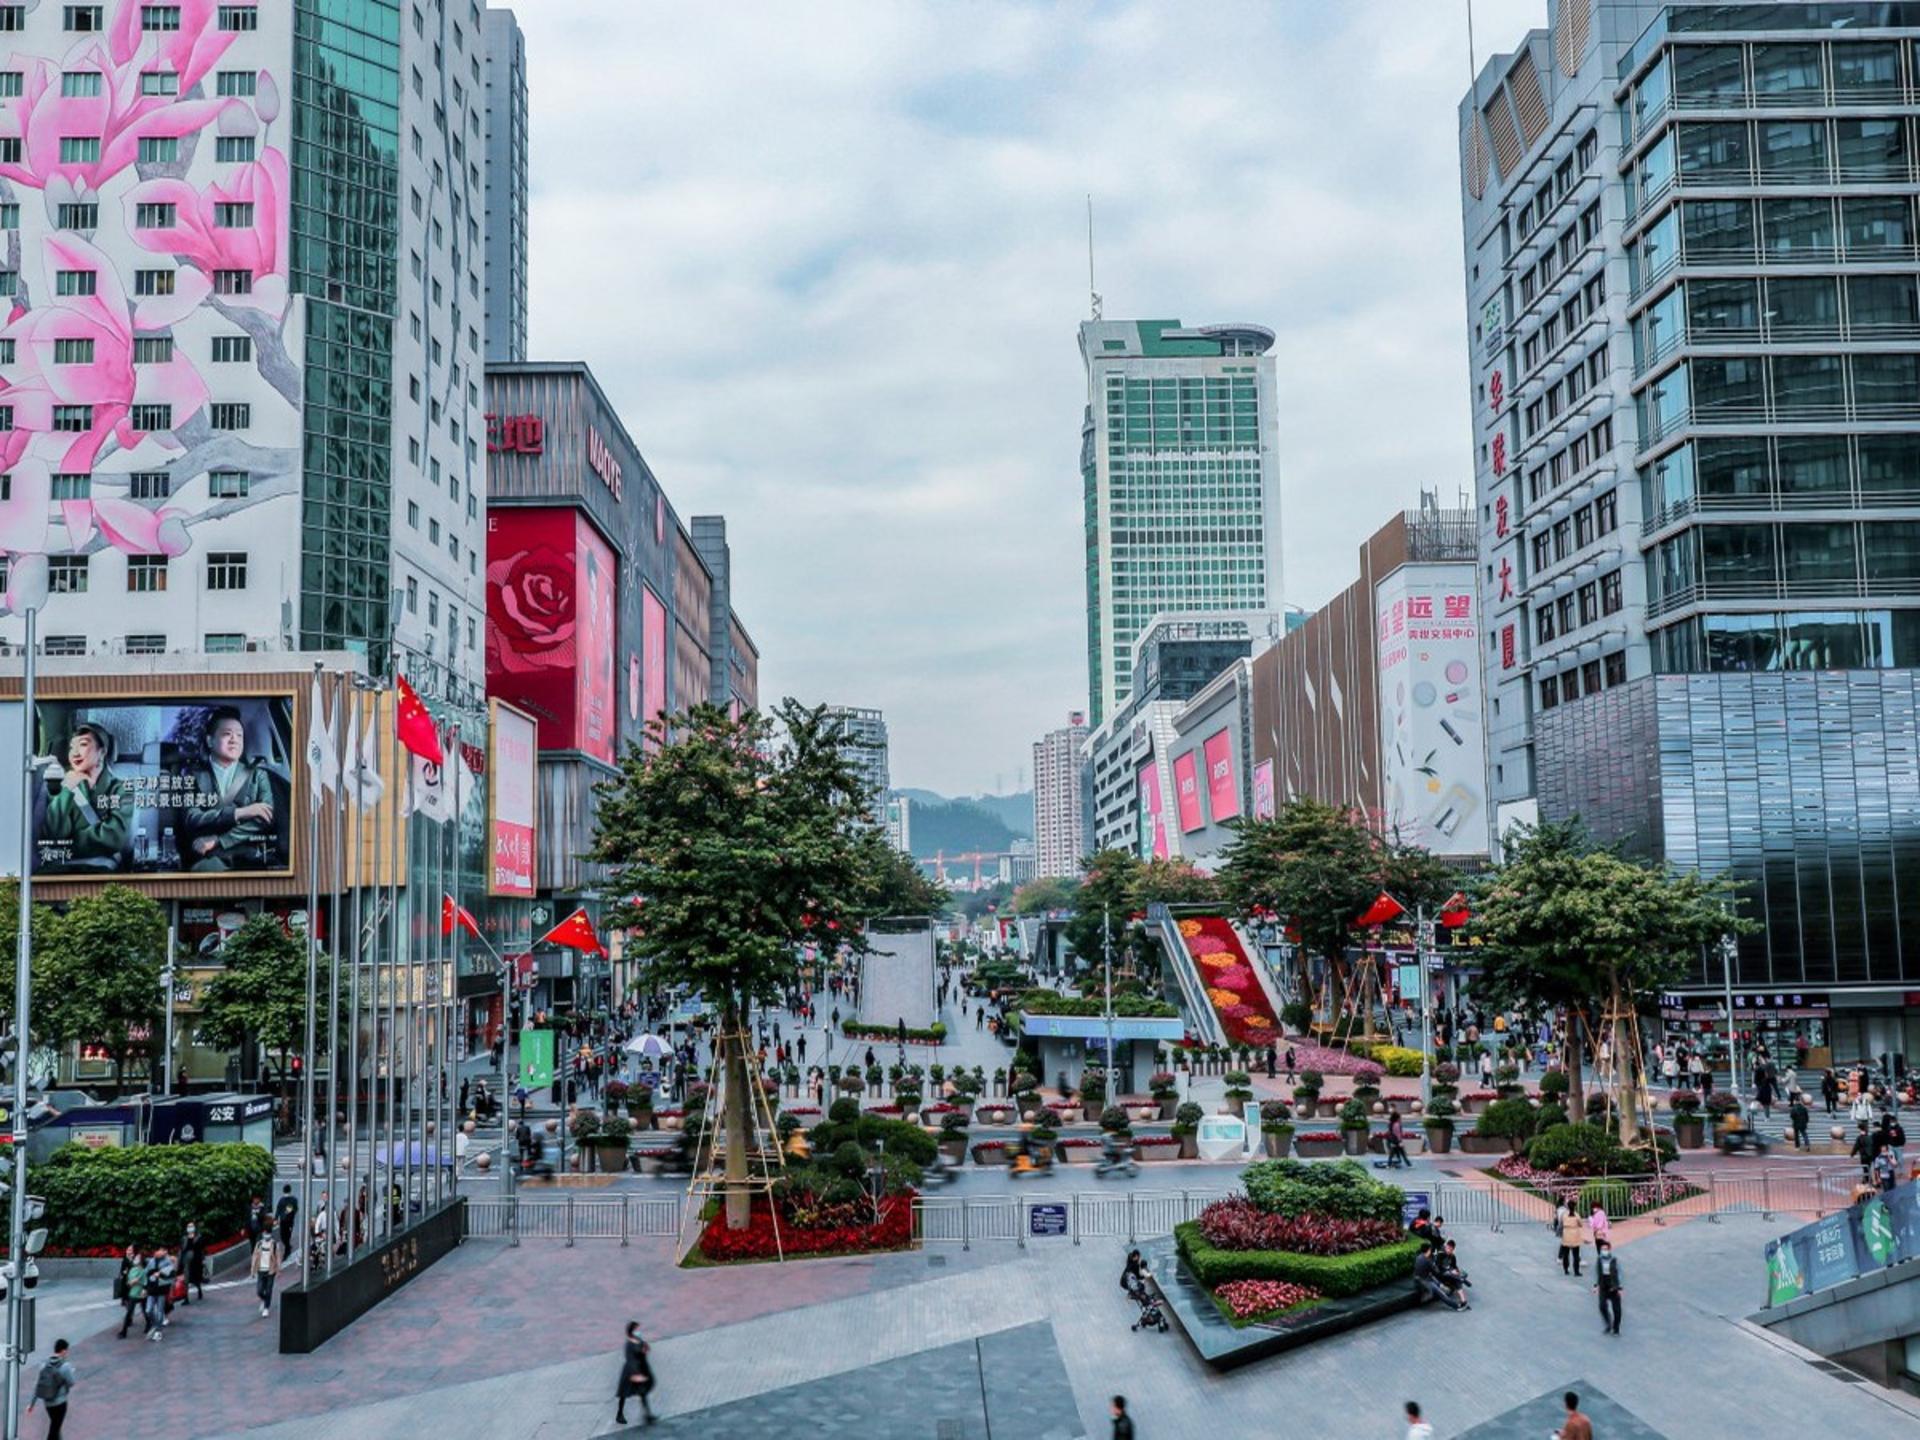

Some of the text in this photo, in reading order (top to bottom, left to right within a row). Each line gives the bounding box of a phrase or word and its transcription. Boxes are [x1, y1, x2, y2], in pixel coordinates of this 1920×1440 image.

[588, 424, 621, 504] MAOYE
[1407, 594, 1472, 619] 远望
[122, 775, 196, 792] 在安静里放空
[96, 792, 219, 809] 欣赏一段风景也很美妙
[210, 1105, 235, 1121] 公安
